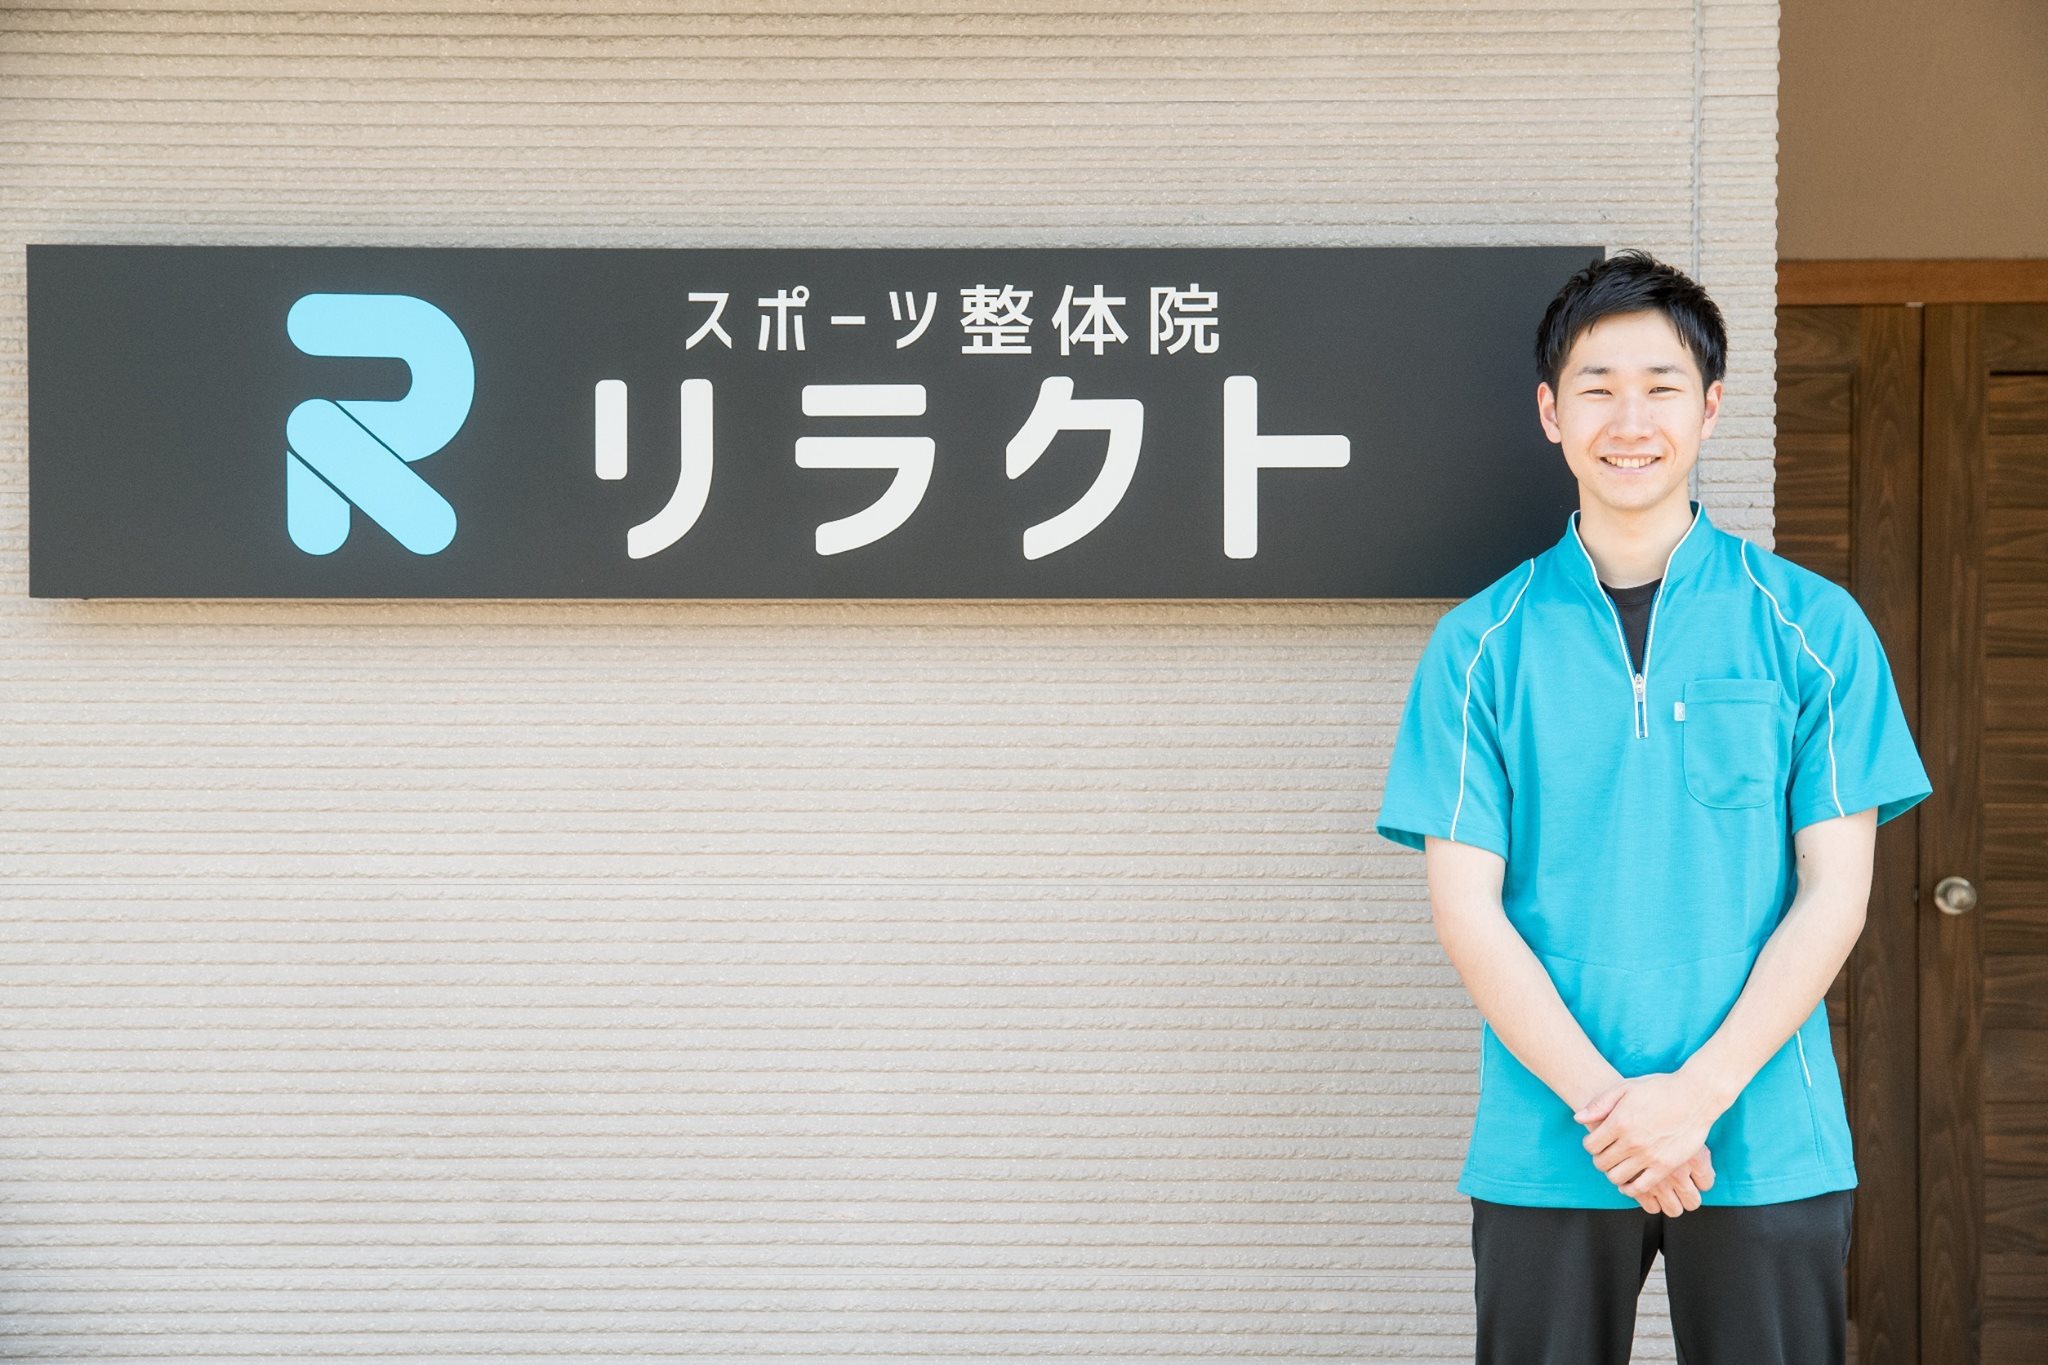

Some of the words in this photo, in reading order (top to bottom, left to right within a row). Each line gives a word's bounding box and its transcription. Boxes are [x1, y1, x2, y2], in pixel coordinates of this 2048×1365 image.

[685, 283, 1220, 355] スポーツ整体院
[286, 293, 475, 556] R
[594, 375, 1351, 561] リラクト
